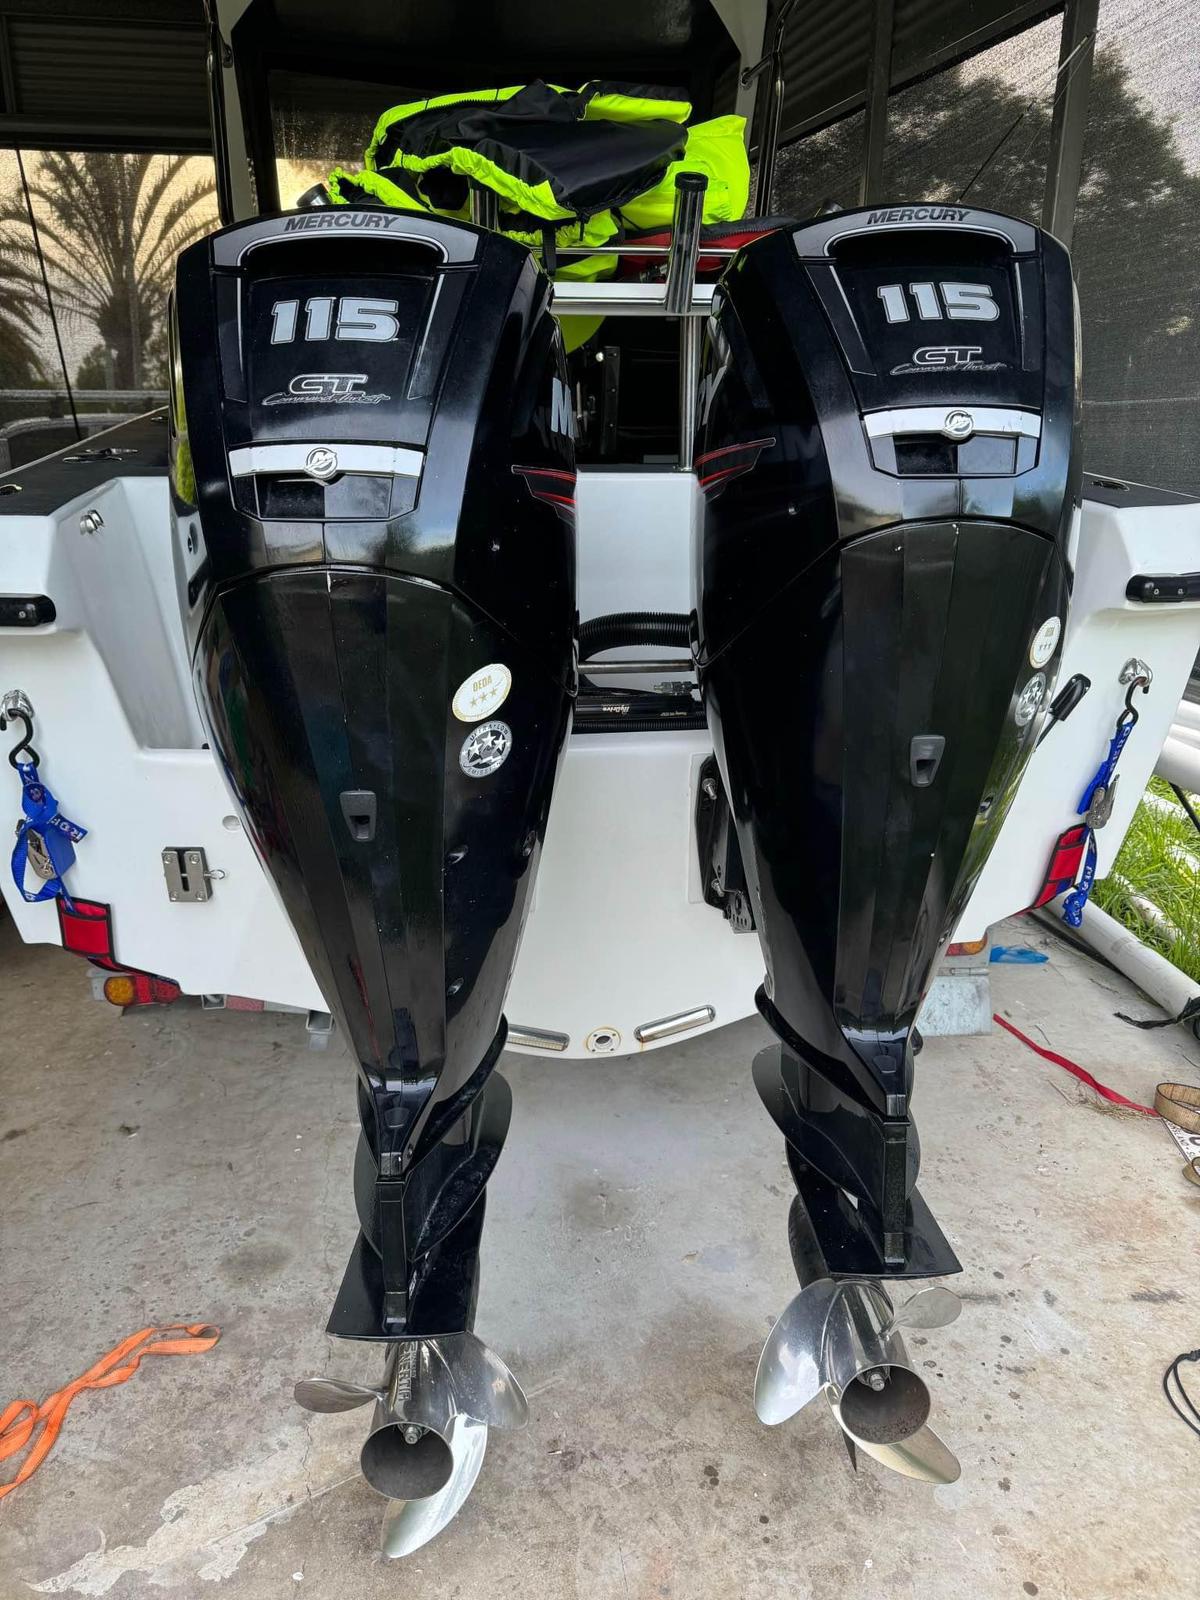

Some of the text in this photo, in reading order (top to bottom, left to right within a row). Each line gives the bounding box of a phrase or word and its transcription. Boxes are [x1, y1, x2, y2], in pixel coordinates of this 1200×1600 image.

[284, 213, 398, 232] MERCURY
[866, 208, 970, 225] MERCURY
[877, 281, 1000, 323] 115
[270, 296, 400, 345] 115
